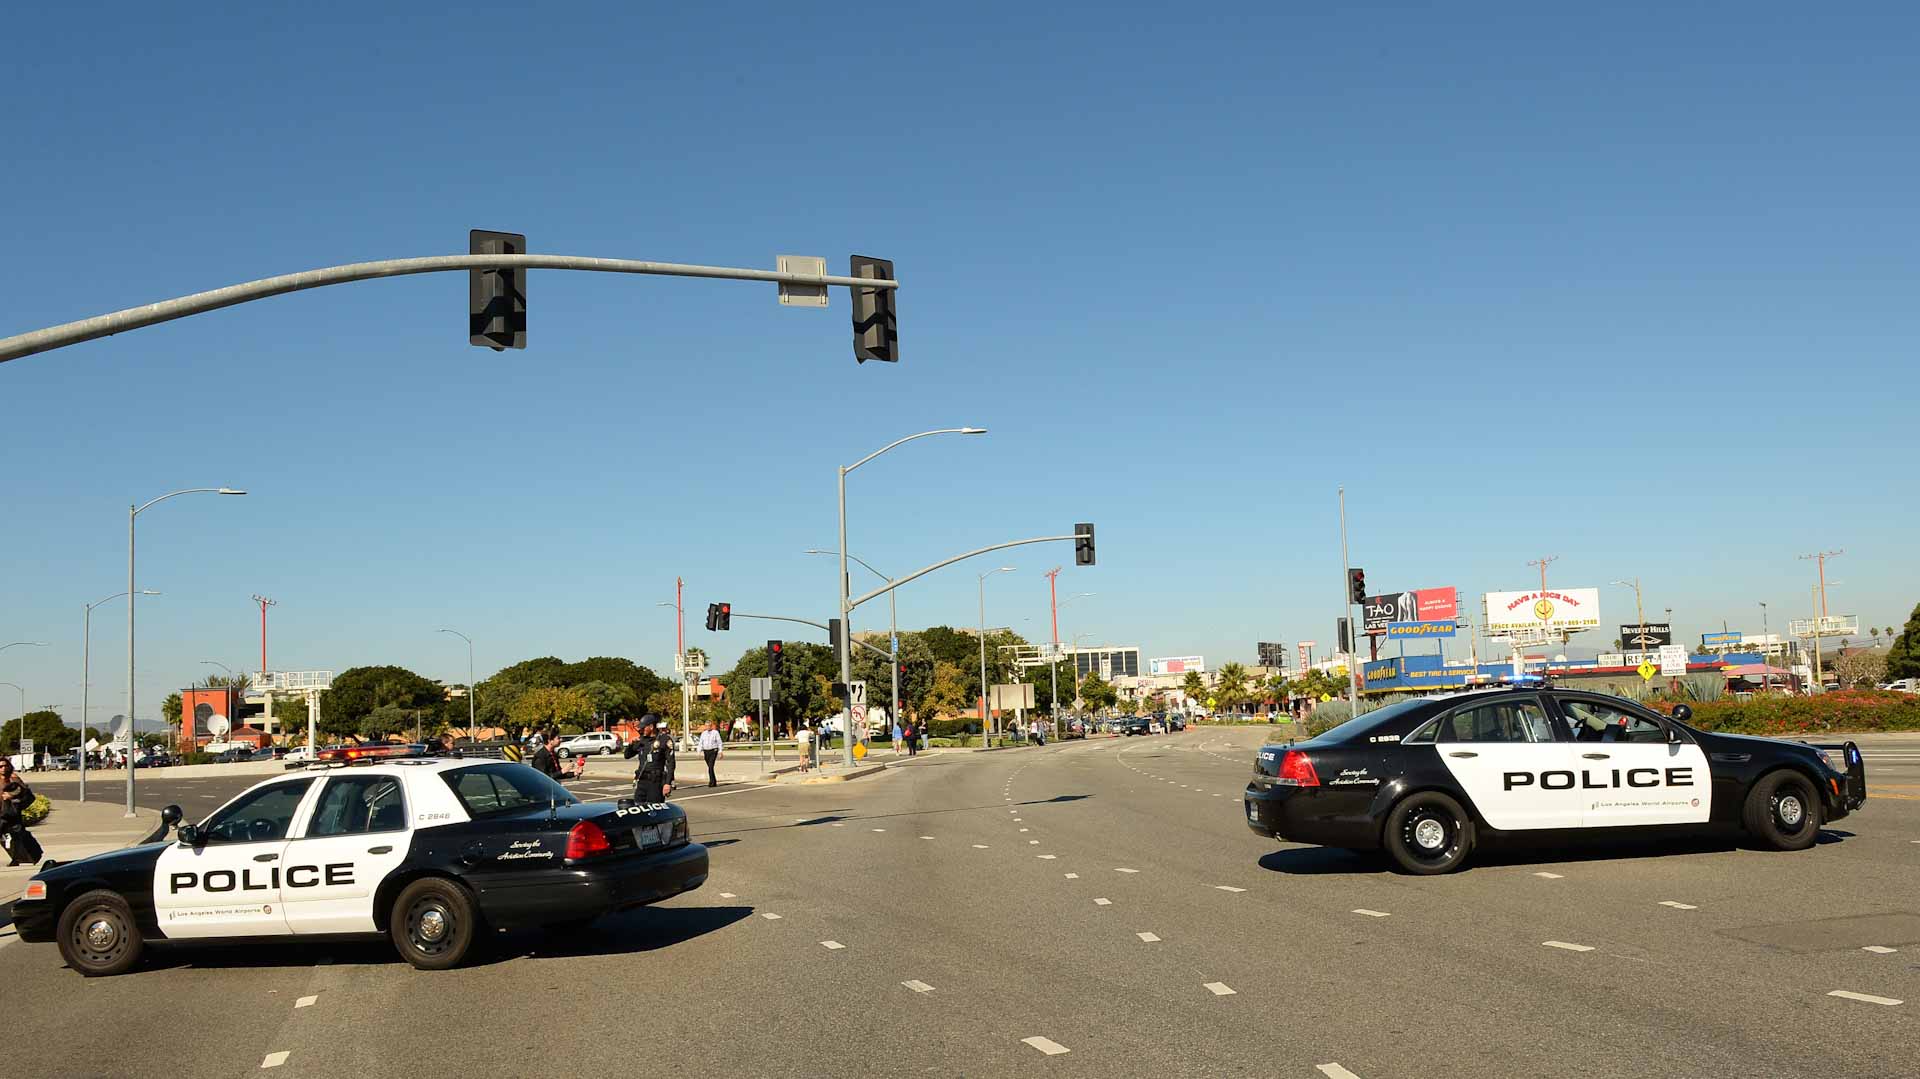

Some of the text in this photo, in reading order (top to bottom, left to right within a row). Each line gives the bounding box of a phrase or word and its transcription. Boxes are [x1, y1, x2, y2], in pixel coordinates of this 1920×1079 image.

[1507, 592, 1581, 611] HAVE A NICE DAY
[1365, 603, 1394, 617] TAO
[1391, 623, 1453, 635] GOODYEAR
[1650, 625, 1669, 633] HILLS
[1367, 665, 1396, 681] GOODYEAR
[1504, 767, 1694, 791] POLICE
[616, 802, 670, 818] POLICE
[510, 840, 532, 850] Serving
[497, 850, 554, 860] Aviation Community
[170, 862, 355, 894] POLICE
